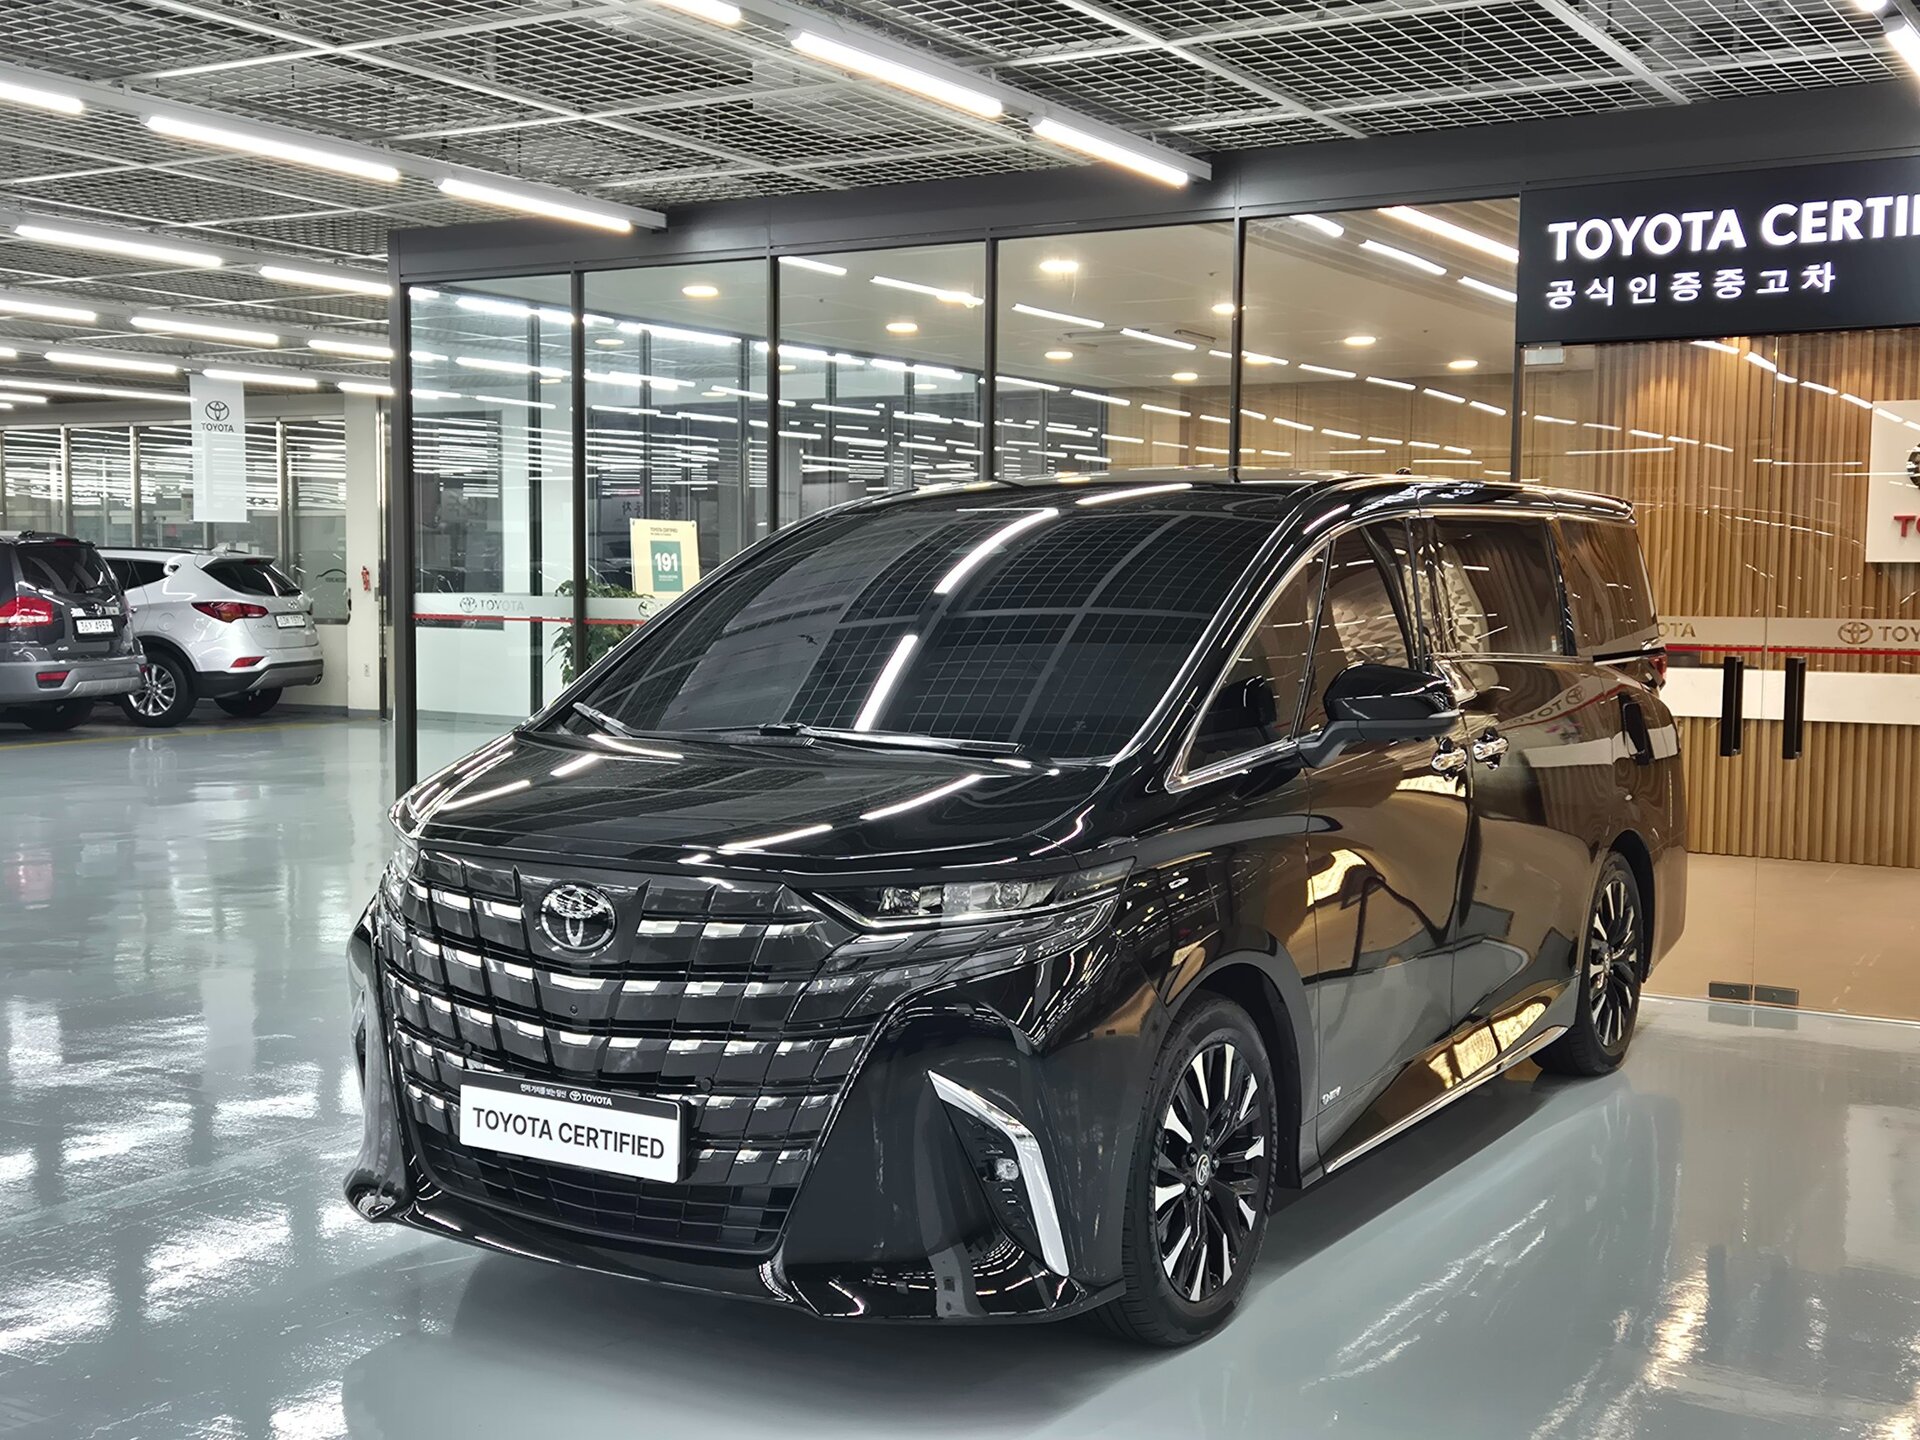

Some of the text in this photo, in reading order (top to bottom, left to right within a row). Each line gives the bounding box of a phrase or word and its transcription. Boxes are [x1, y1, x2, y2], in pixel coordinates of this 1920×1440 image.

[1547, 208, 1747, 262] TOYOTA
[201, 422, 235, 432] TOYOTA
[1893, 515, 1920, 537] T
[654, 552, 679, 572] 191
[480, 599, 525, 612] TOYOTA
[582, 1093, 613, 1106] TOYOTA
[472, 1107, 665, 1159] TOYOTA CERTIFIED
